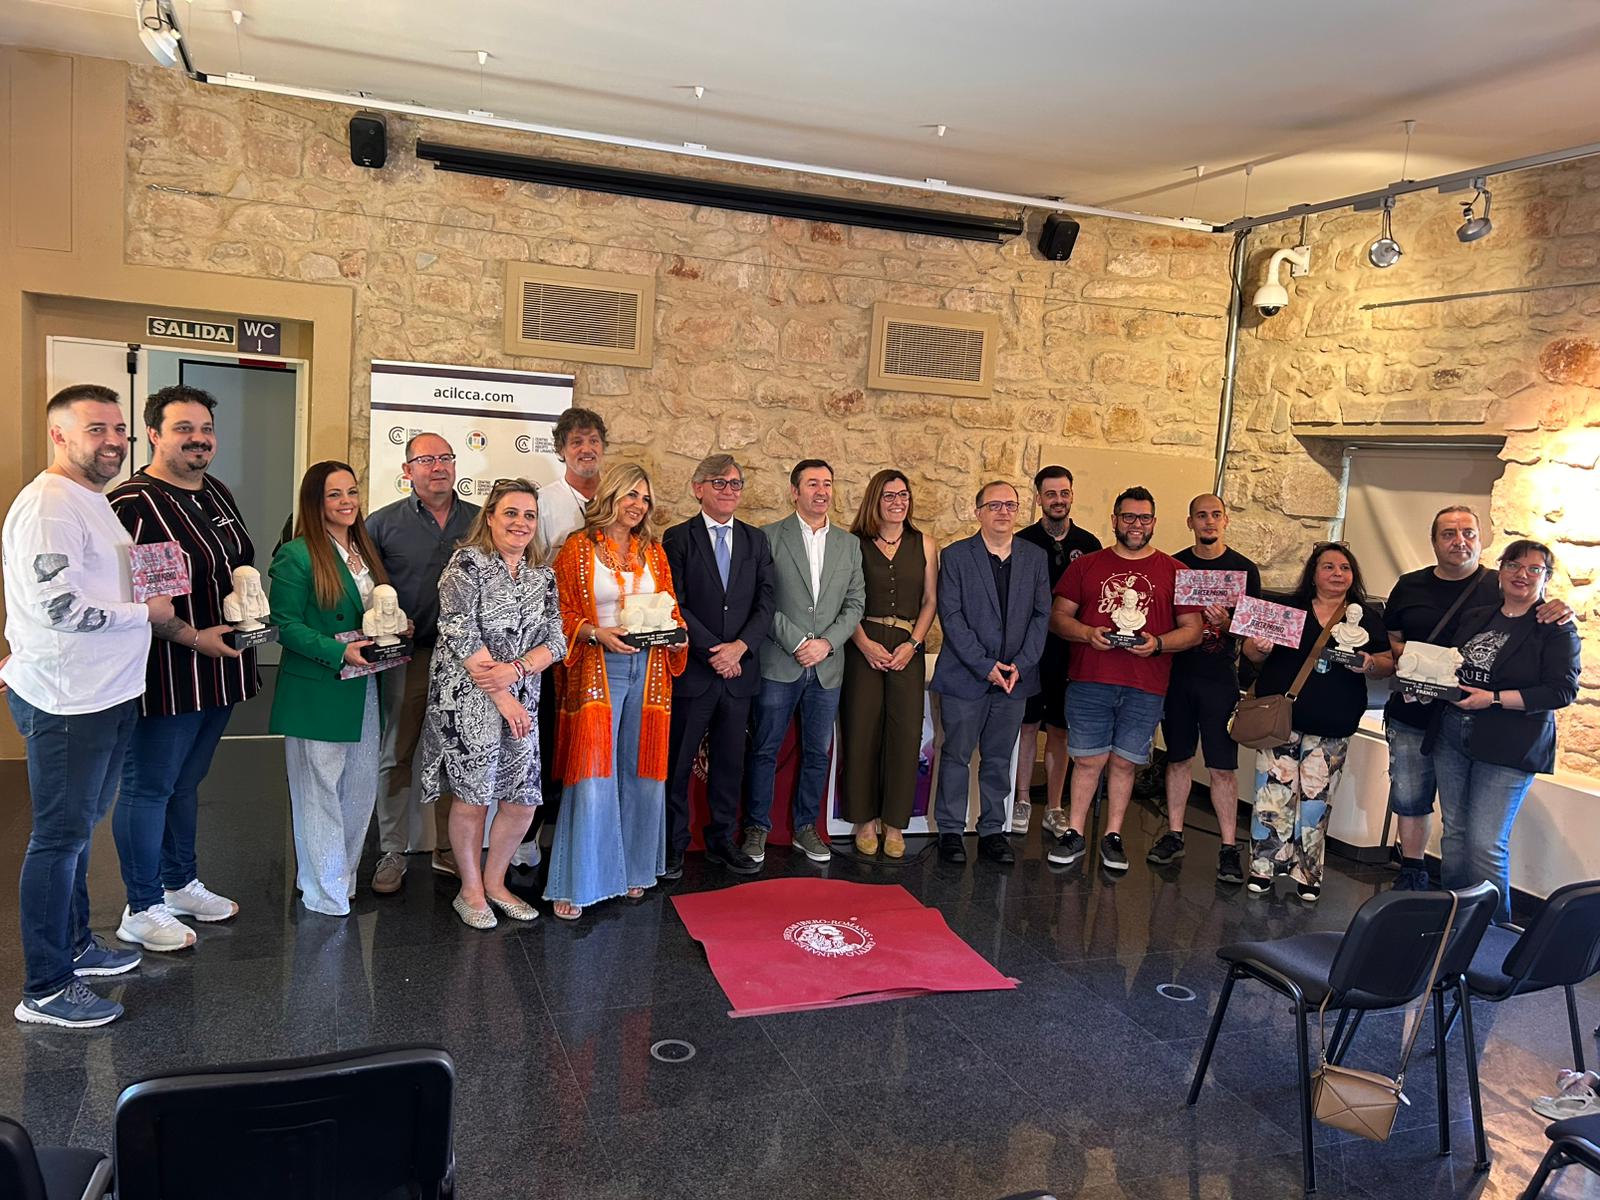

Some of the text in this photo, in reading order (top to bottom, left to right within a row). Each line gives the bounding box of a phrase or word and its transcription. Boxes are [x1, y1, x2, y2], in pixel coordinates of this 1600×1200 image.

[152, 320, 230, 342] SALIDA
[244, 321, 275, 339] WC
[433, 386, 514, 403] acilcca.com
[1456, 668, 1491, 685] QUEE
